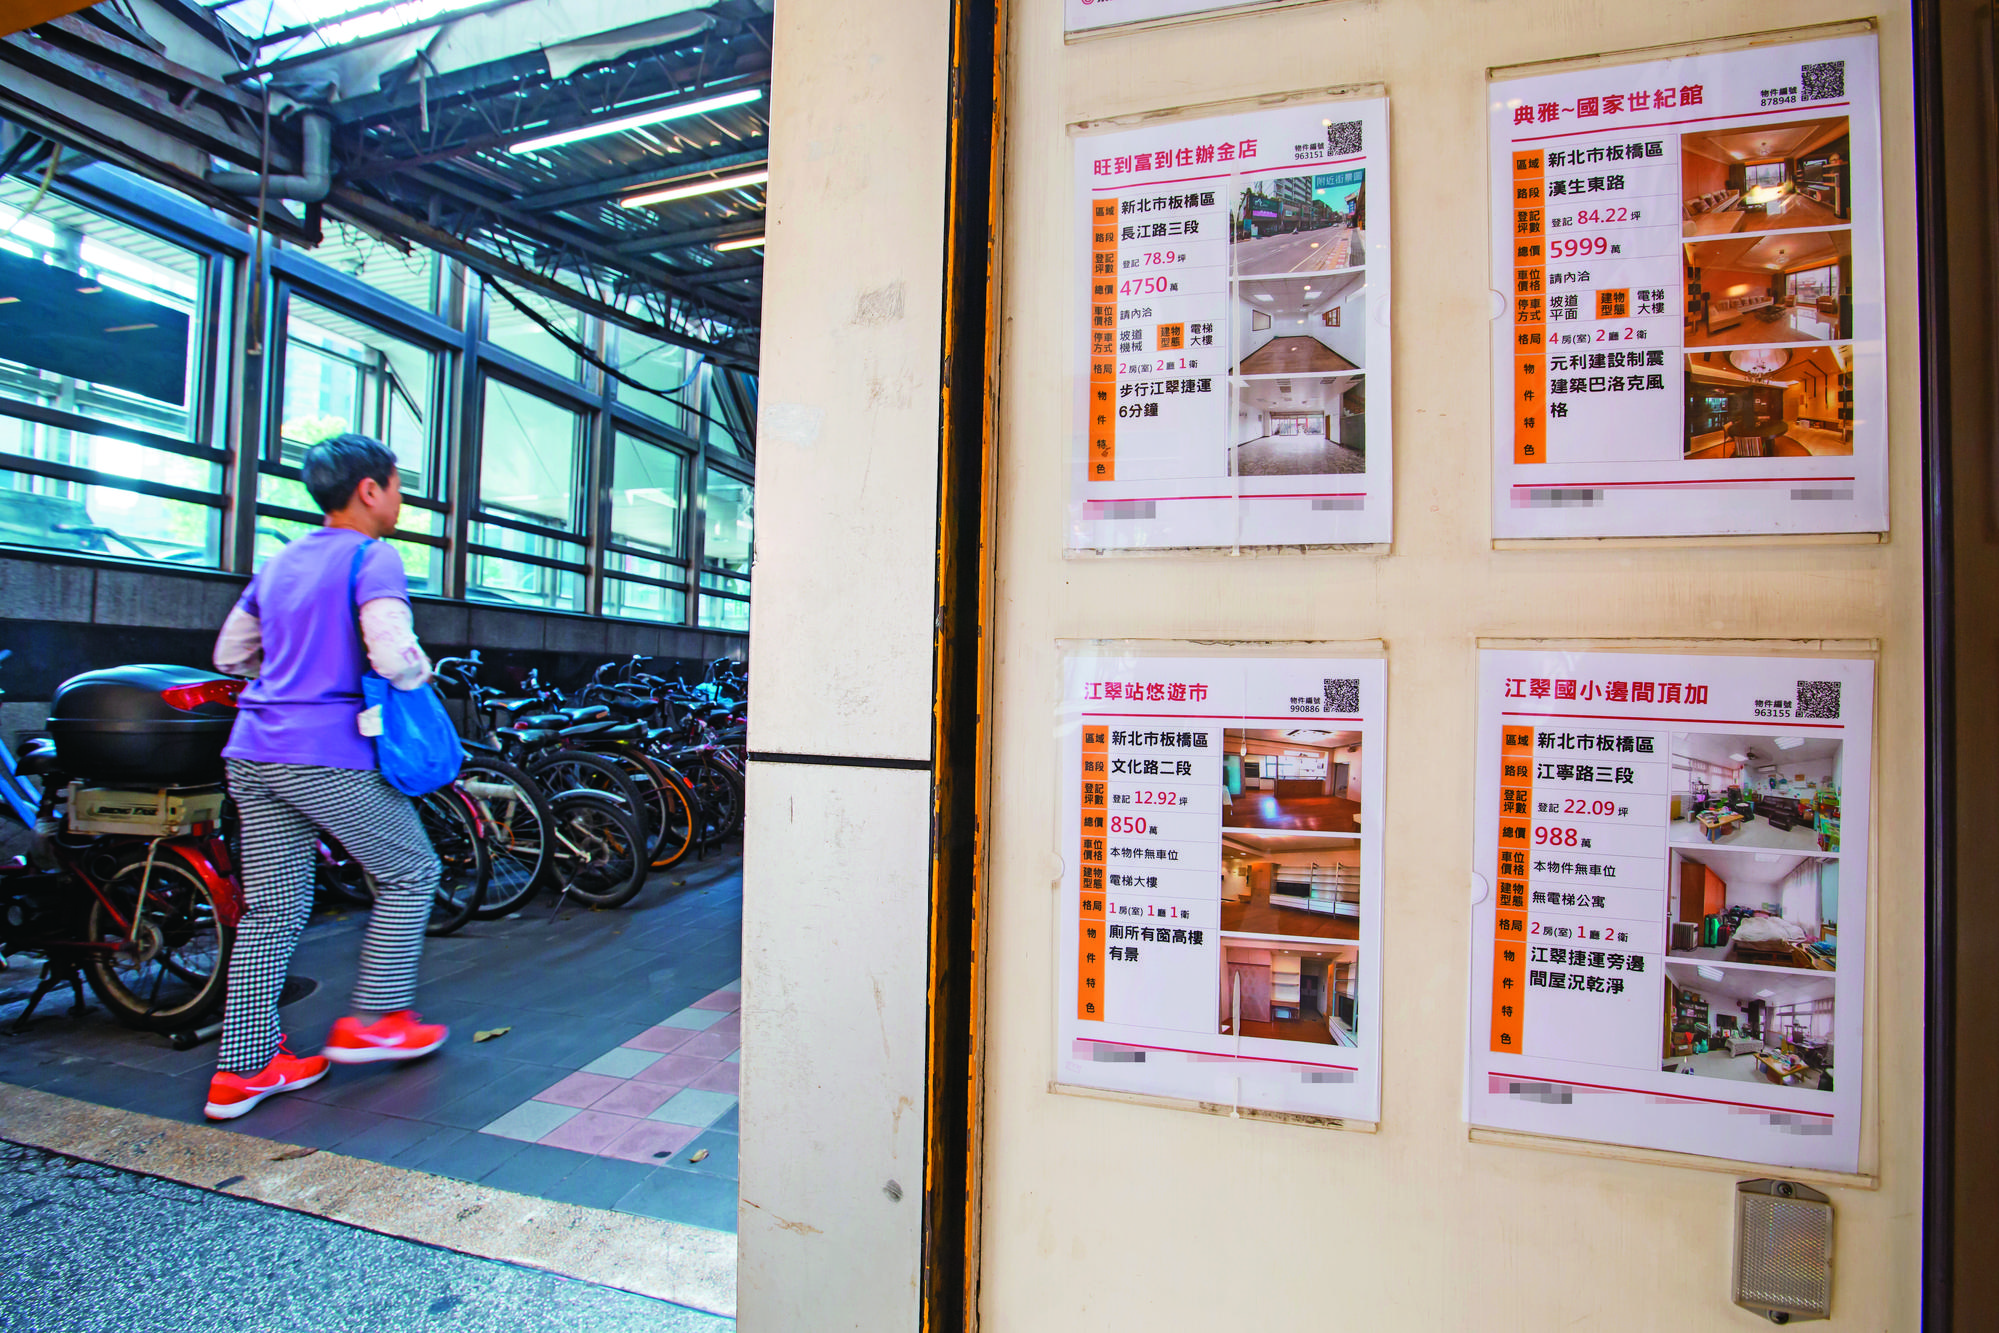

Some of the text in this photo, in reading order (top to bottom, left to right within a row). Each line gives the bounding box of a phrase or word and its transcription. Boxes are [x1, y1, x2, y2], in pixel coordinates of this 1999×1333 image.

[1760, 86, 1798, 98] 物件編號
[1513, 83, 1704, 126] 典雅~國家世紀館
[1760, 96, 1797, 107] 878948
[1294, 142, 1325, 152] 物件編號
[1093, 138, 1258, 176] 旺到富到住辦金店
[1294, 150, 1324, 160] 963151
[1548, 141, 1663, 168] 新北市板橋區
[1516, 158, 1539, 170] 區域
[1549, 175, 1625, 197] 漢生東路
[1517, 187, 1539, 199] 路段
[1121, 191, 1215, 215] 新北市板橋區
[1095, 206, 1115, 217] 區域
[1517, 210, 1540, 222] 登記
[1552, 217, 1573, 227] 登記
[1577, 207, 1627, 225] 84.22
[1121, 220, 1199, 241] 長江路三段
[1518, 222, 1540, 233] 坪數
[1095, 232, 1114, 243] 路段
[1517, 245, 1540, 257] 總價
[1550, 237, 1608, 258] 5999
[1095, 253, 1114, 263] 登記
[1122, 259, 1140, 269] 登記
[1143, 250, 1175, 266] 78.9
[1095, 263, 1114, 274] 坪數
[1518, 269, 1540, 280] 車位
[1549, 270, 1590, 284] 請內洽
[1094, 285, 1113, 295] 總價
[1120, 276, 1168, 296] 4750
[1518, 280, 1541, 291] 價格
[1550, 294, 1578, 308] 坡道
[1601, 292, 1625, 303] 建物
[1637, 289, 1665, 301] 電梯
[1518, 298, 1541, 310] 停車
[1601, 304, 1625, 316] 型態
[1637, 302, 1665, 314] 大樓
[1094, 306, 1113, 316] 車位
[1120, 307, 1153, 320] 請內洽
[1518, 310, 1541, 322] 方式
[1550, 308, 1578, 321] 平面
[1094, 316, 1113, 326] 價格
[1161, 326, 1181, 337] 建物
[1190, 322, 1213, 334] 電梯
[1094, 332, 1113, 342] 停車
[1120, 329, 1143, 341] 坡道
[1190, 335, 1213, 346] 大樓
[1518, 333, 1541, 345] 格局
[1120, 341, 1143, 353] 機械
[1161, 336, 1181, 347] 型態
[1094, 343, 1113, 353] 方式
[1550, 350, 1664, 371] 元利建設制震
[1093, 364, 1113, 374] 格局
[1120, 378, 1212, 398] 步行江翠捷運
[1550, 374, 1664, 394] 建築巴洛克風
[1119, 402, 1159, 418] 6分鐘
[1550, 402, 1568, 418] 格
[1084, 681, 1208, 702] 江翠站悠遊市
[1504, 677, 1709, 705] 江翠國小邊間頂加
[1290, 696, 1321, 705] 物件編號
[1754, 699, 1792, 709] 物件編號
[1290, 705, 1320, 713] 990886
[1754, 708, 1791, 718] 963155
[1085, 733, 1104, 743] 區域
[1112, 731, 1208, 748] 新北市板橋區
[1505, 734, 1529, 747] 區域
[1538, 732, 1655, 753] 新北市板橋區
[1085, 761, 1104, 772] 路段
[1111, 758, 1192, 776] 文化路二段
[1504, 765, 1528, 778] 路段
[1537, 763, 1634, 784] 江寧路三段
[1084, 783, 1104, 794] 登記
[1084, 794, 1104, 805] 坪數
[1112, 794, 1130, 804] 登記
[1135, 790, 1176, 805] 12.92
[1504, 790, 1527, 802] 登記
[1503, 802, 1527, 814] 坪數
[1538, 803, 1559, 813] 登記
[1564, 799, 1615, 816] 22.09
[1084, 817, 1104, 827] 總價
[1110, 816, 1147, 834] 850
[1502, 827, 1526, 839] 總價
[1535, 826, 1578, 847] 988
[1083, 839, 1102, 850] 車位
[1083, 850, 1102, 861] 價格
[1110, 847, 1179, 861] 本物件無車位
[1501, 851, 1524, 863] 車位
[1083, 867, 1102, 878] 建物
[1501, 863, 1524, 876] 價格
[1533, 860, 1616, 878] 本物件無車位
[1082, 878, 1102, 889] 型態
[1109, 874, 1158, 888] 電梯大樓
[1500, 882, 1524, 894] 建物
[1082, 900, 1102, 911] 格局
[1500, 894, 1523, 907] 型態
[1532, 891, 1606, 909] 無電梯公寓
[1499, 919, 1523, 932] 格局
[1109, 925, 1204, 945] 廁所有窗高樓
[1109, 946, 1139, 962] 有景
[1531, 946, 1645, 973] 江翠捷運旁邊
[1529, 969, 1625, 995] 間屋況乾淨
